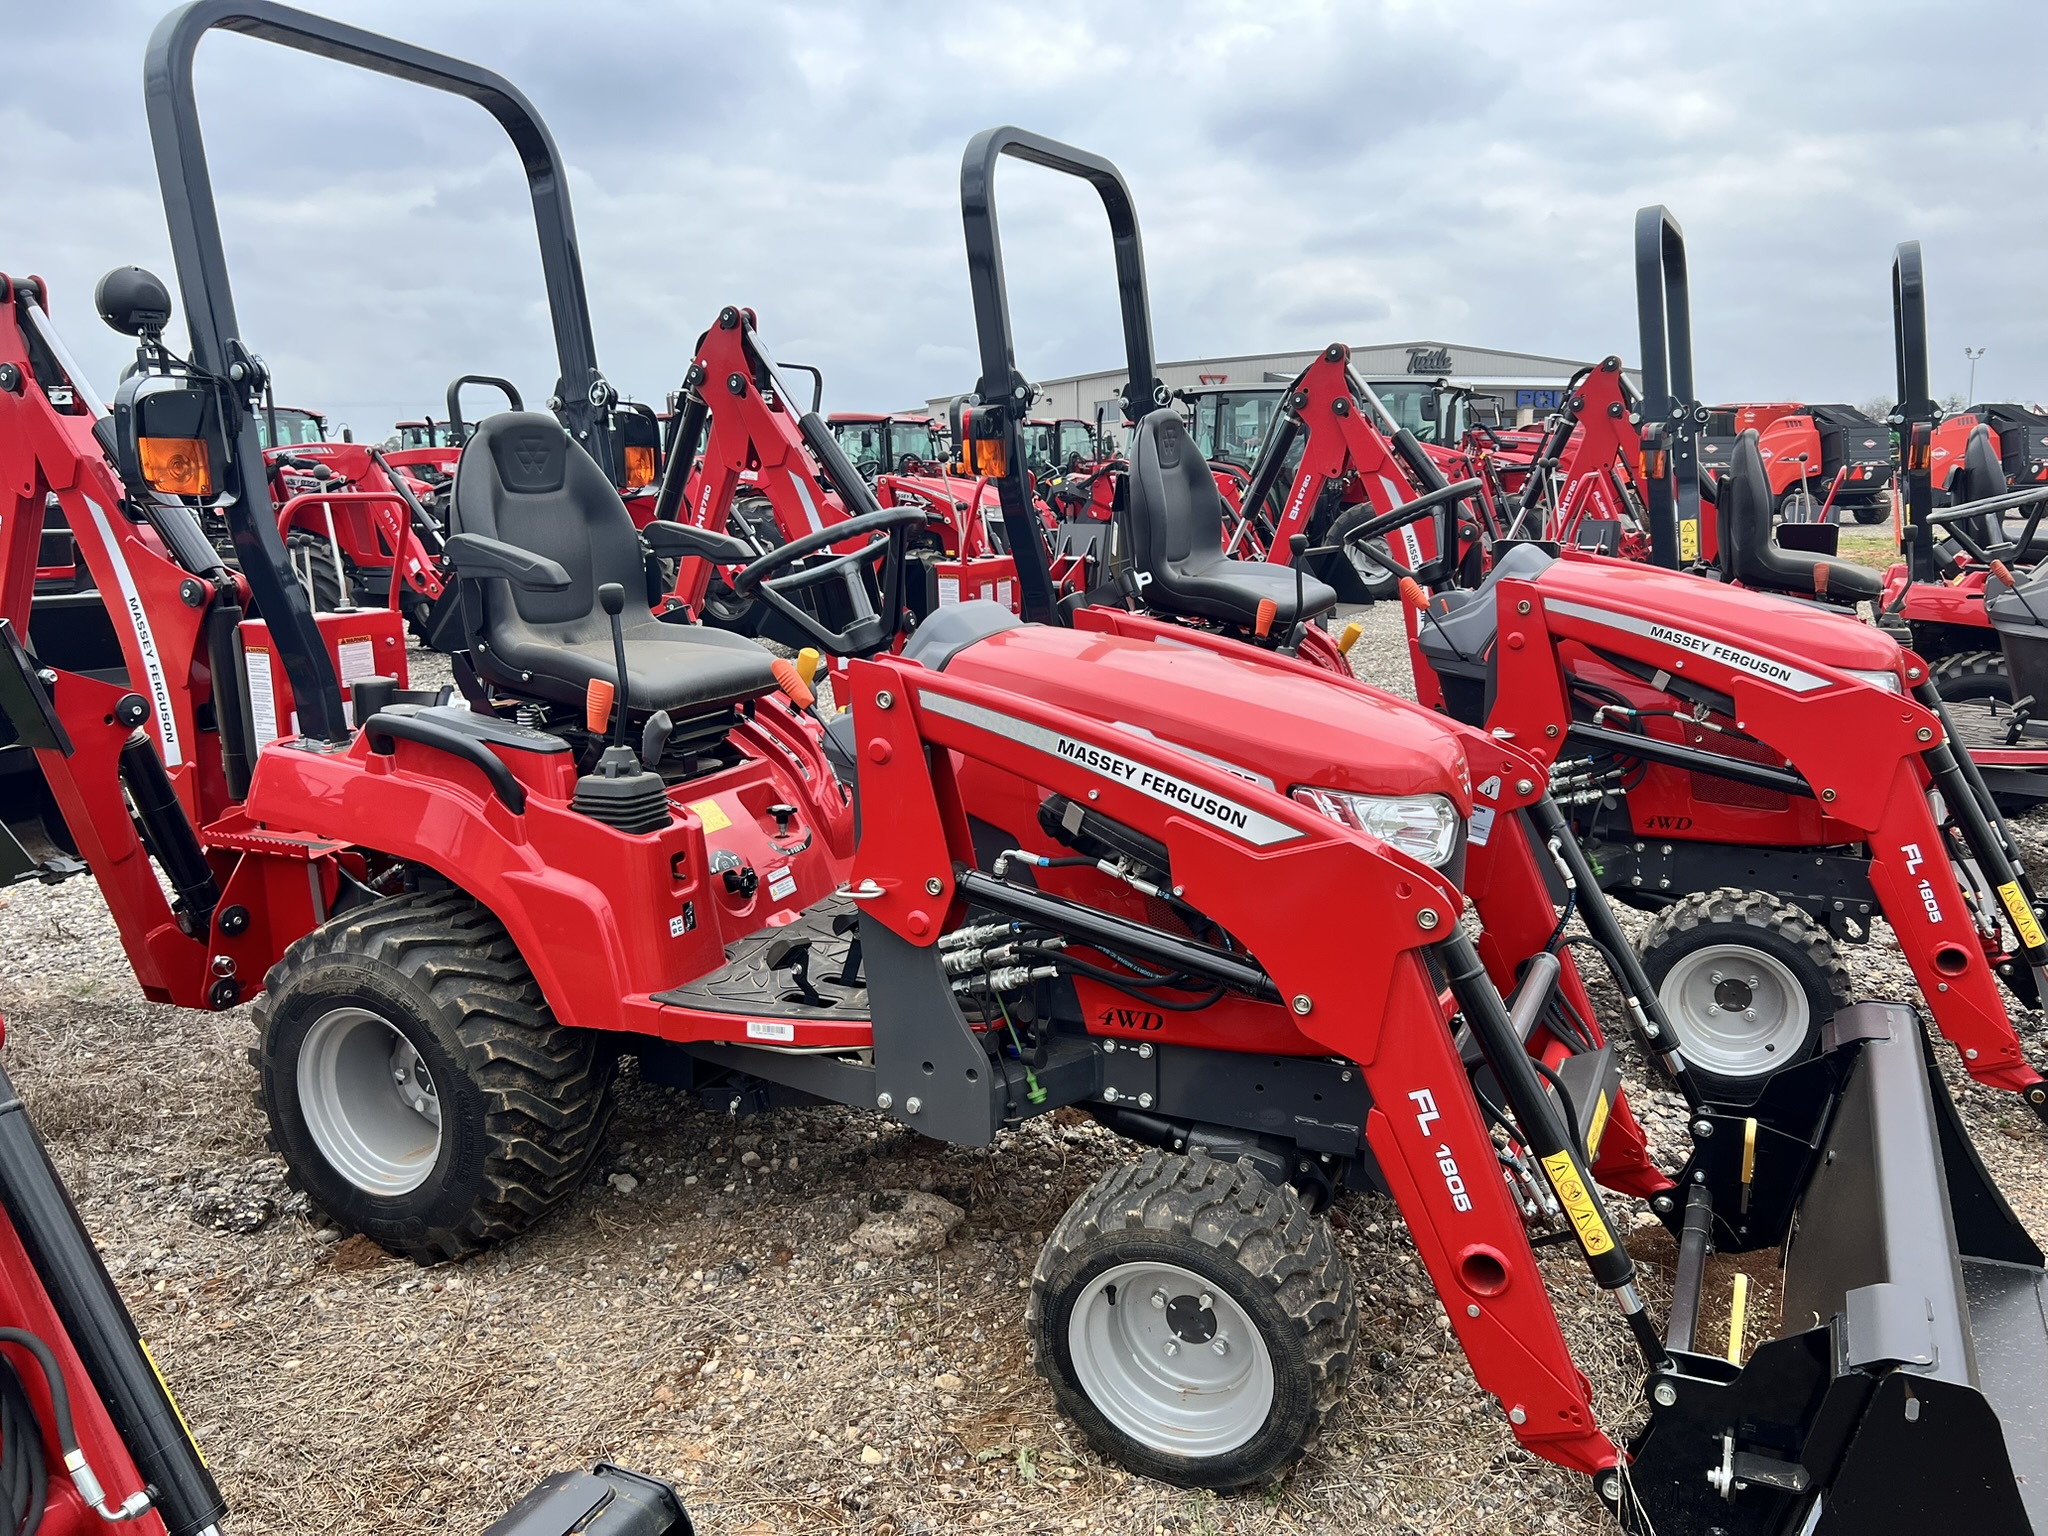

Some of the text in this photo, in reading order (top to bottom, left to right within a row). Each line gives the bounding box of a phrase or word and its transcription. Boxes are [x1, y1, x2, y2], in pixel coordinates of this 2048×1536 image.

[1406, 347, 1452, 373] Tuttle
[700, 484, 712, 516] 2720
[1289, 474, 1312, 520] BH 2720
[129, 597, 175, 743] MASSEY FERGUSON
[1650, 626, 1791, 682] MASSEY FERGUSON
[1057, 738, 1248, 829] MASSEY FERGUSON
[1642, 815, 1693, 830] 4WD
[1900, 843, 1943, 923] FL 1805
[1098, 1007, 1164, 1031] 4WD
[1407, 1087, 1473, 1212] FL 1805
